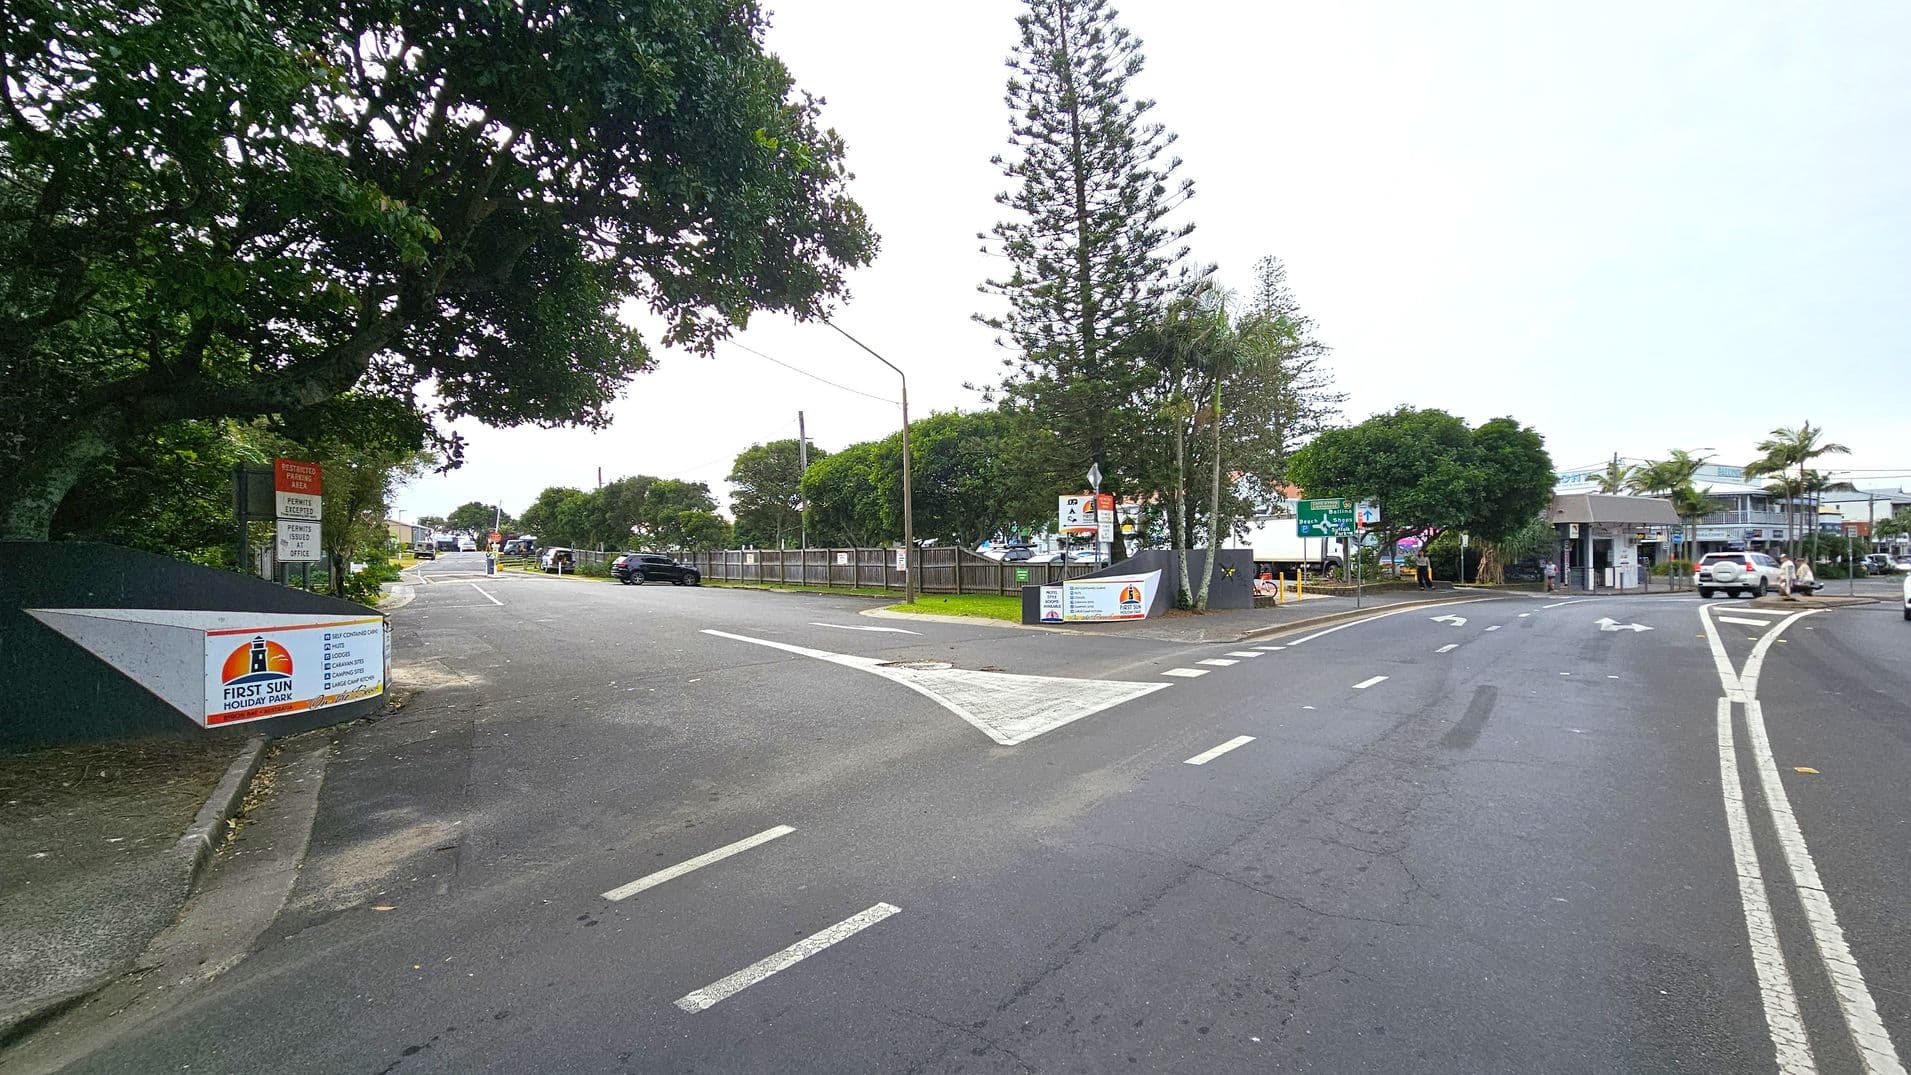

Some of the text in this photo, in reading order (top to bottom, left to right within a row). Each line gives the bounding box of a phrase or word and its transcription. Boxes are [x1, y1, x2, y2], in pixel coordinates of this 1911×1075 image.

[282, 463, 316, 475] RESTRICTED
[287, 473, 312, 482] PARKING
[287, 497, 311, 506] PERMITS
[285, 506, 313, 515] EXCEPTED
[287, 524, 312, 533] PERMITS
[289, 533, 310, 541] ISSUED
[332, 651, 350, 659] LODGES
[332, 660, 353, 668] CARAVAN
[332, 667, 364, 678] CAMPING SITES
[223, 680, 292, 700] FIRST SUN
[223, 692, 293, 710] HOLIDAY PARK
